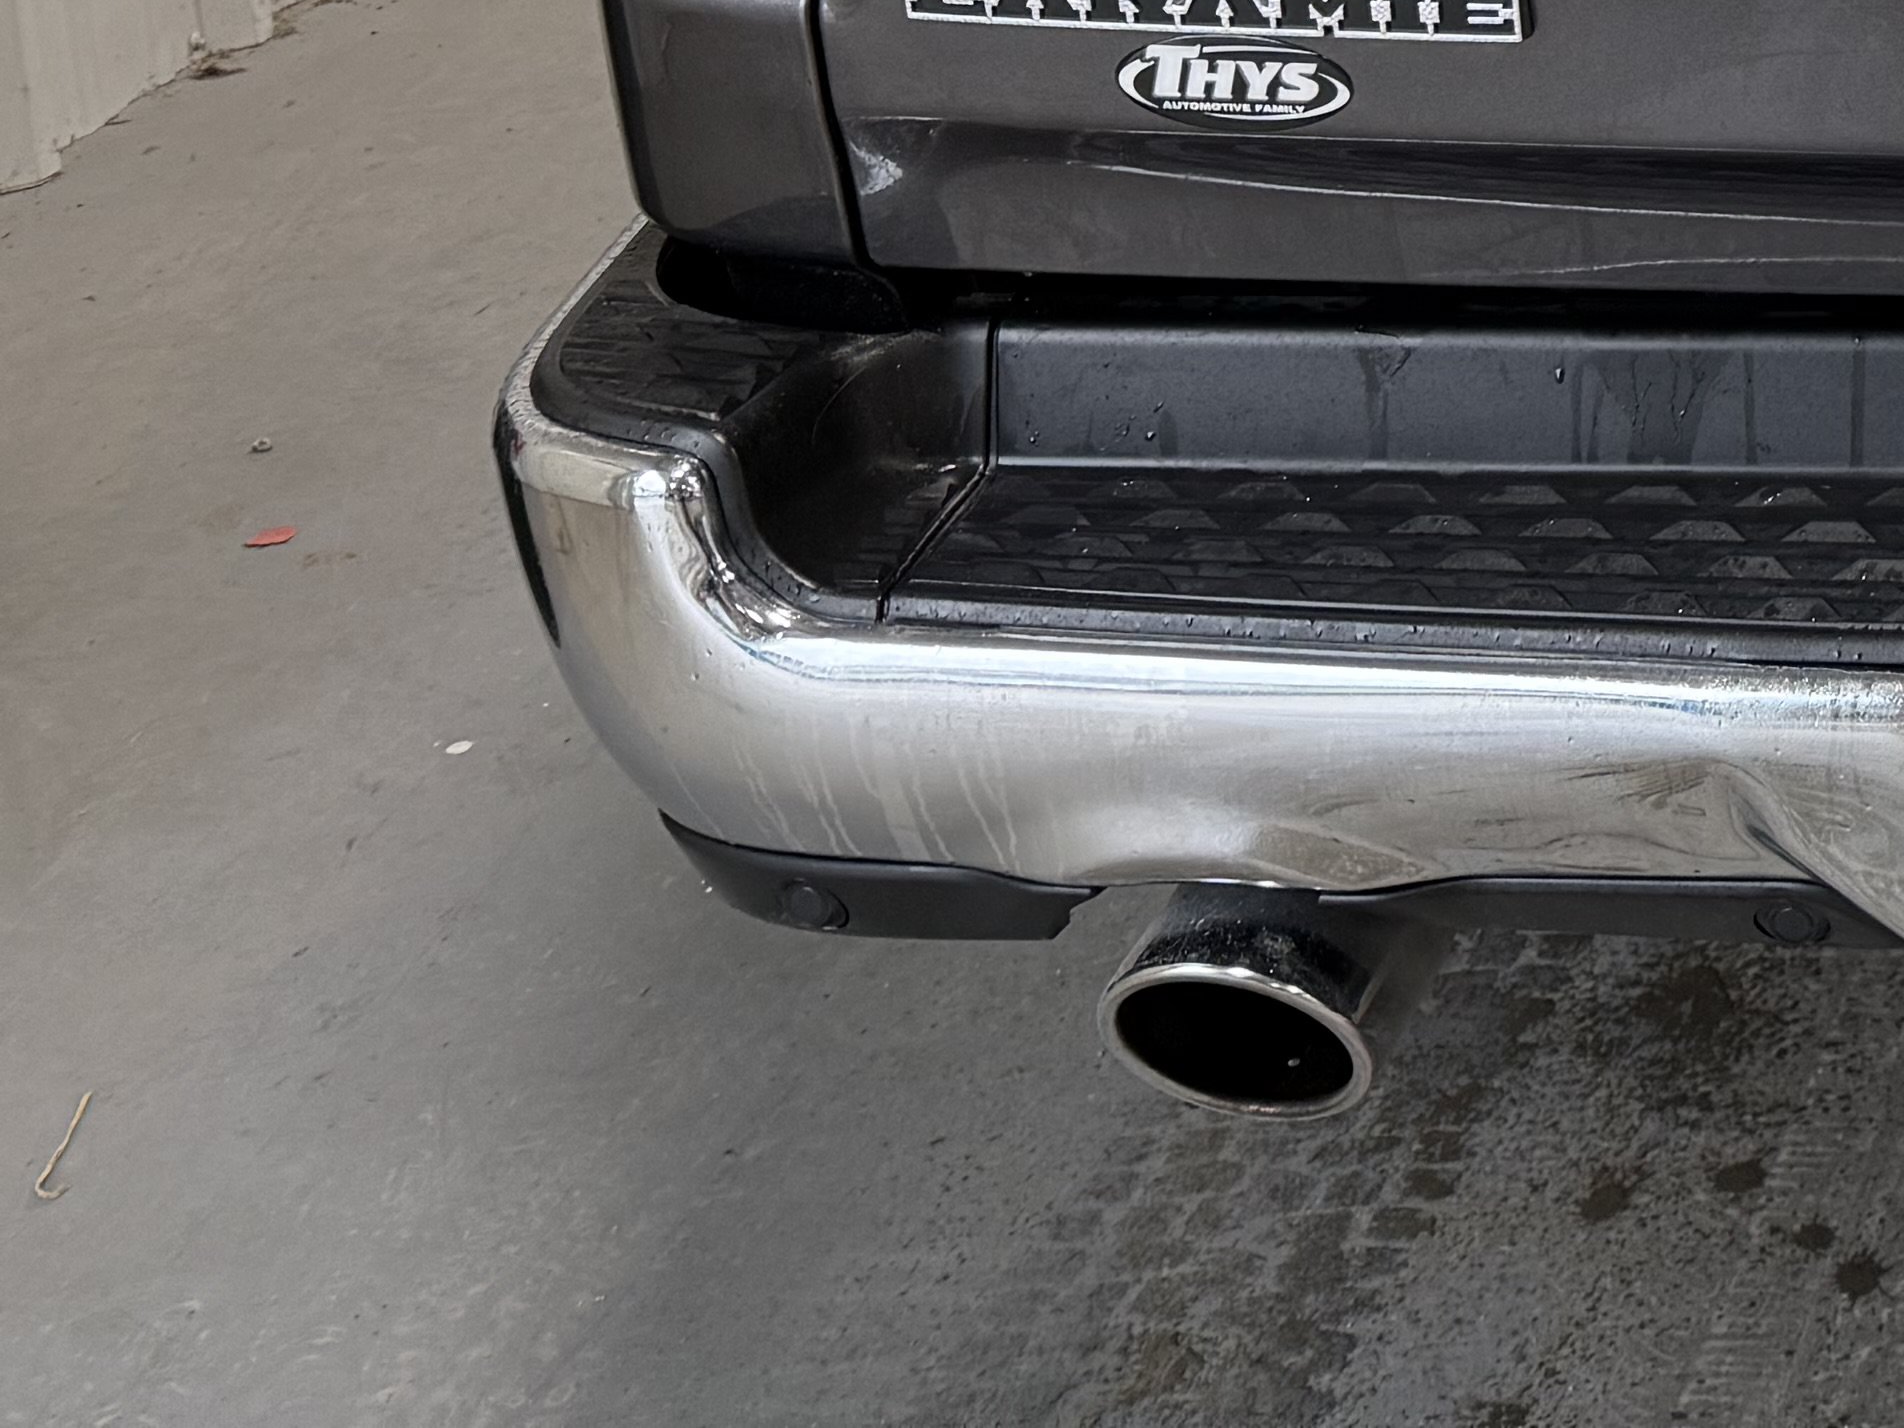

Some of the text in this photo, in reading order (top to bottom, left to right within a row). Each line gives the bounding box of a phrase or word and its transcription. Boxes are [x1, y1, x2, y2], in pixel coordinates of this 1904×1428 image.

[1145, 44, 1320, 102] THYS
[1162, 99, 1306, 115] AUTOMOTIVE FAMILY
